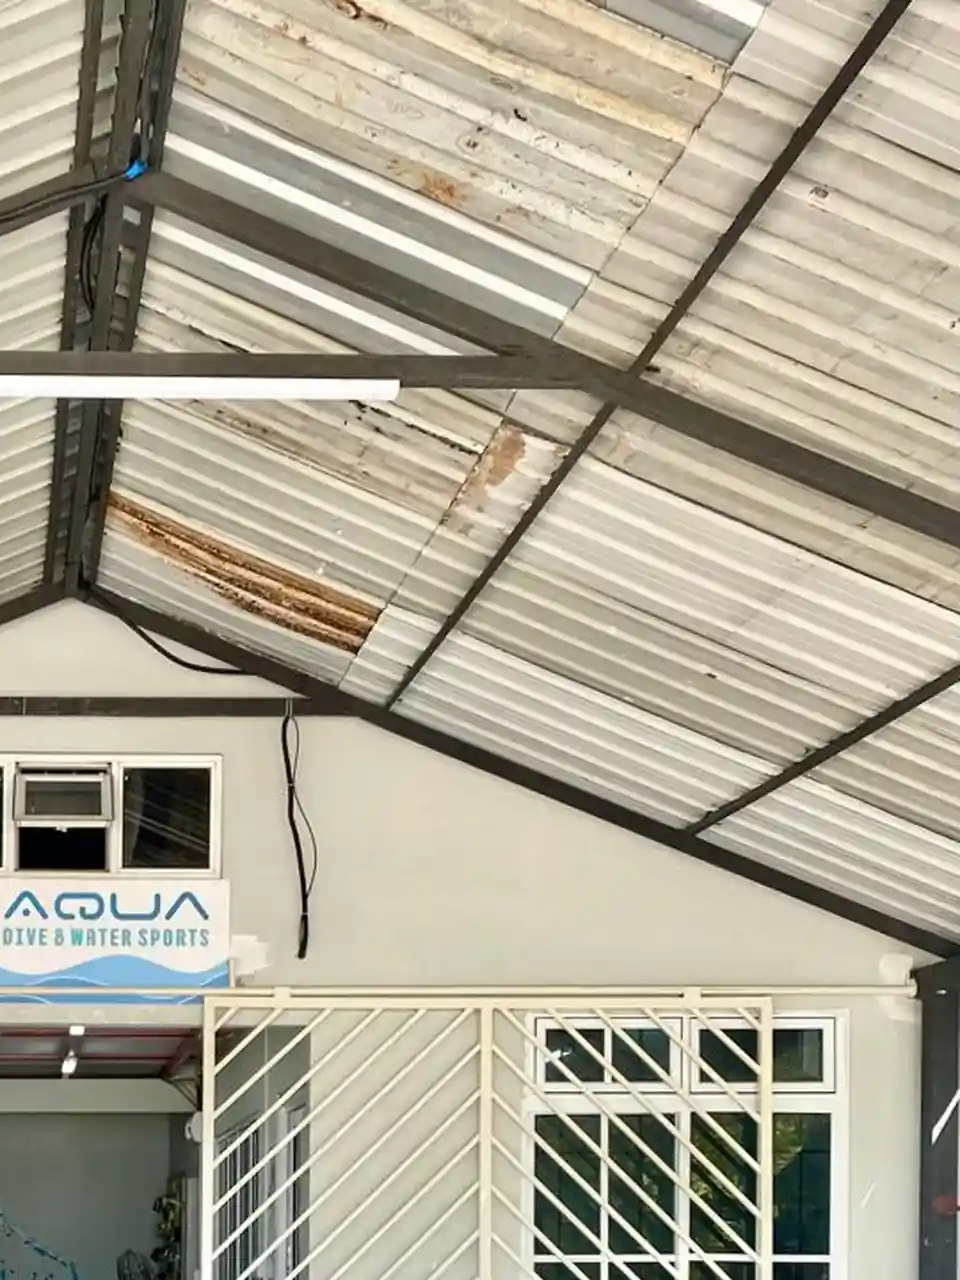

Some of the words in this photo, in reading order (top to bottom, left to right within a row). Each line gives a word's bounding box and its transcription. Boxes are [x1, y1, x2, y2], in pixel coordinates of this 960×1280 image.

[4, 890, 209, 921] AQUA
[2, 928, 48, 947] DIVE
[54, 928, 65, 947] &
[70, 928, 132, 947] WATER
[138, 928, 210, 947] SPORTS
